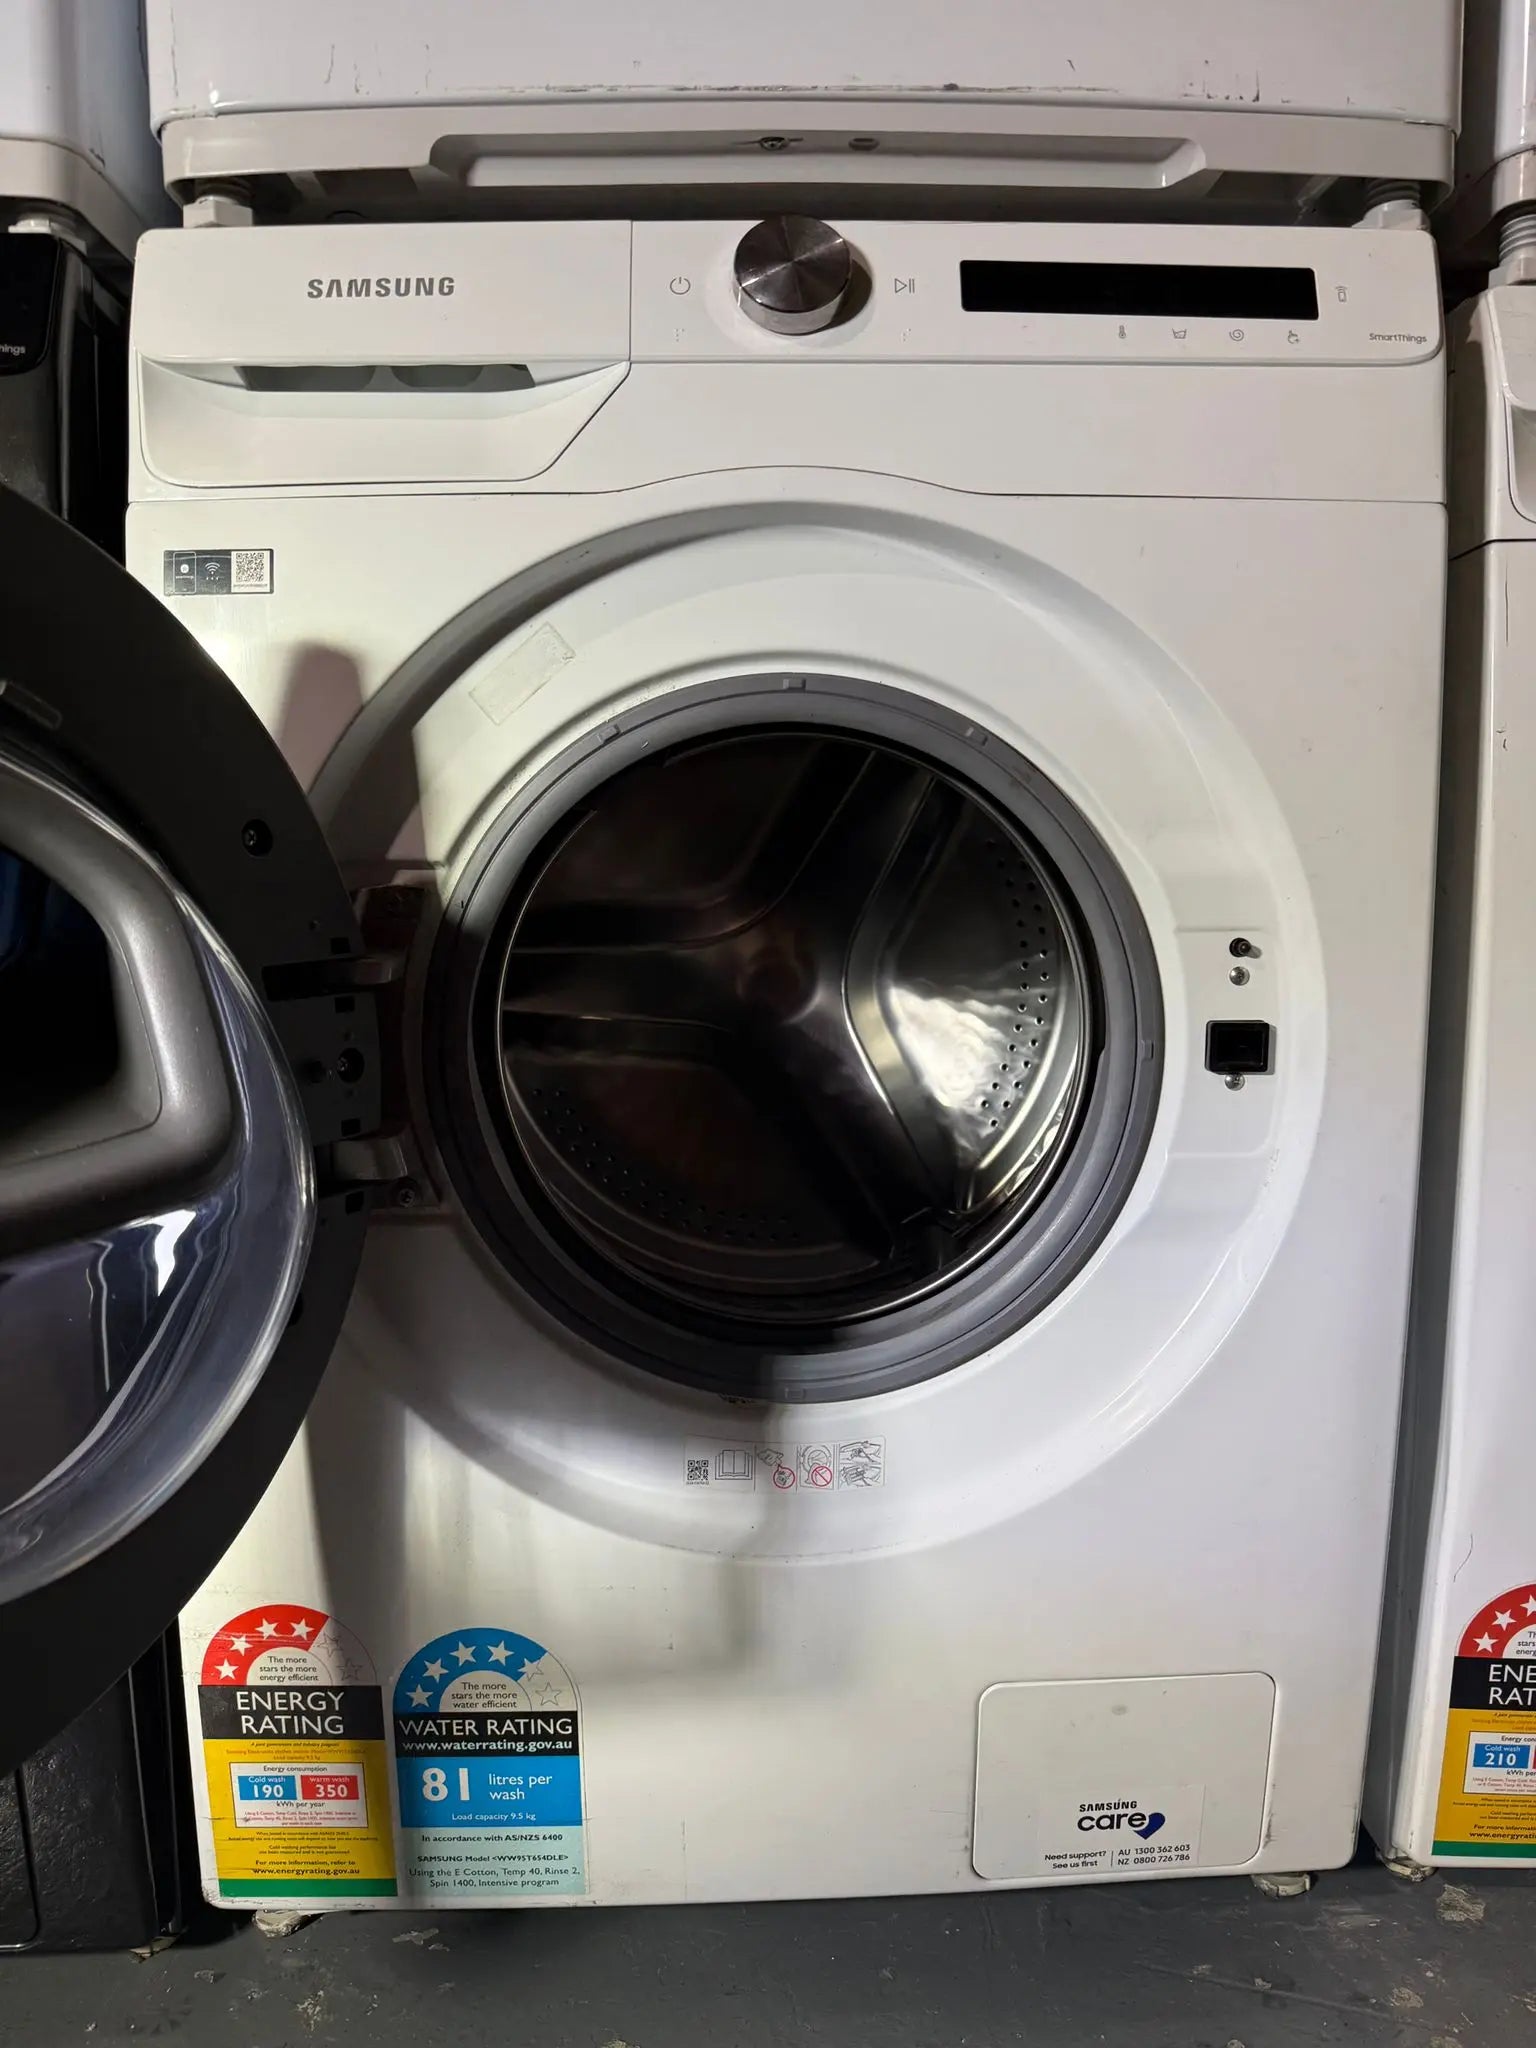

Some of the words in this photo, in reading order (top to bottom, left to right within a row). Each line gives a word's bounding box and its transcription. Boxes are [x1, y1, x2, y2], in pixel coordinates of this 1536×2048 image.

[307, 277, 455, 299] SAMSUNG
[1369, 333, 1427, 344] SmartThings
[267, 1656, 283, 1664] The
[1489, 1664, 1536, 1683] ENE
[462, 1682, 479, 1690] The
[236, 1691, 344, 1711] ENERGY
[475, 1691, 490, 1699] the
[1489, 1687, 1536, 1706] RAT
[241, 1715, 344, 1734] RATING
[399, 1720, 479, 1736] WATER
[487, 1718, 573, 1735] RATING
[1501, 1735, 1522, 1743] Energy
[402, 1740, 573, 1752] www.waterrating.gov.au
[1485, 1753, 1516, 1766] 210
[422, 1767, 471, 1802] 81
[488, 1774, 523, 1785] litres
[529, 1775, 553, 1788] per
[253, 1784, 284, 1798] 190
[316, 1784, 348, 1798] 350
[489, 1788, 525, 1801] wash
[1079, 1800, 1138, 1813] SAMSUNG
[475, 1813, 508, 1821] capacity
[526, 1813, 536, 1821] kg
[1077, 1811, 1147, 1832] care
[1044, 1851, 1068, 1861] Need
[1069, 1850, 1107, 1861] support?
[1118, 1849, 1131, 1857] AU
[1135, 1847, 1155, 1856] 1300
[1156, 1845, 1173, 1854] 362
[1174, 1844, 1190, 1853] 603
[1052, 1862, 1068, 1870] See
[1082, 1860, 1098, 1868] first
[1117, 1858, 1129, 1866] NZ
[1133, 1856, 1156, 1865] 0800
[1157, 1854, 1173, 1864] 726
[1174, 1853, 1190, 1862] 786
[252, 1868, 360, 1876] www.energyrating.gov.au
[409, 1869, 434, 1878] Using
[463, 1868, 499, 1877] Cotton,
[503, 1868, 526, 1878] Temp
[430, 1879, 449, 1888] Spin
[453, 1879, 477, 1888] 1400,
[479, 1879, 518, 1887] Intensive
[521, 1879, 559, 1888] program
